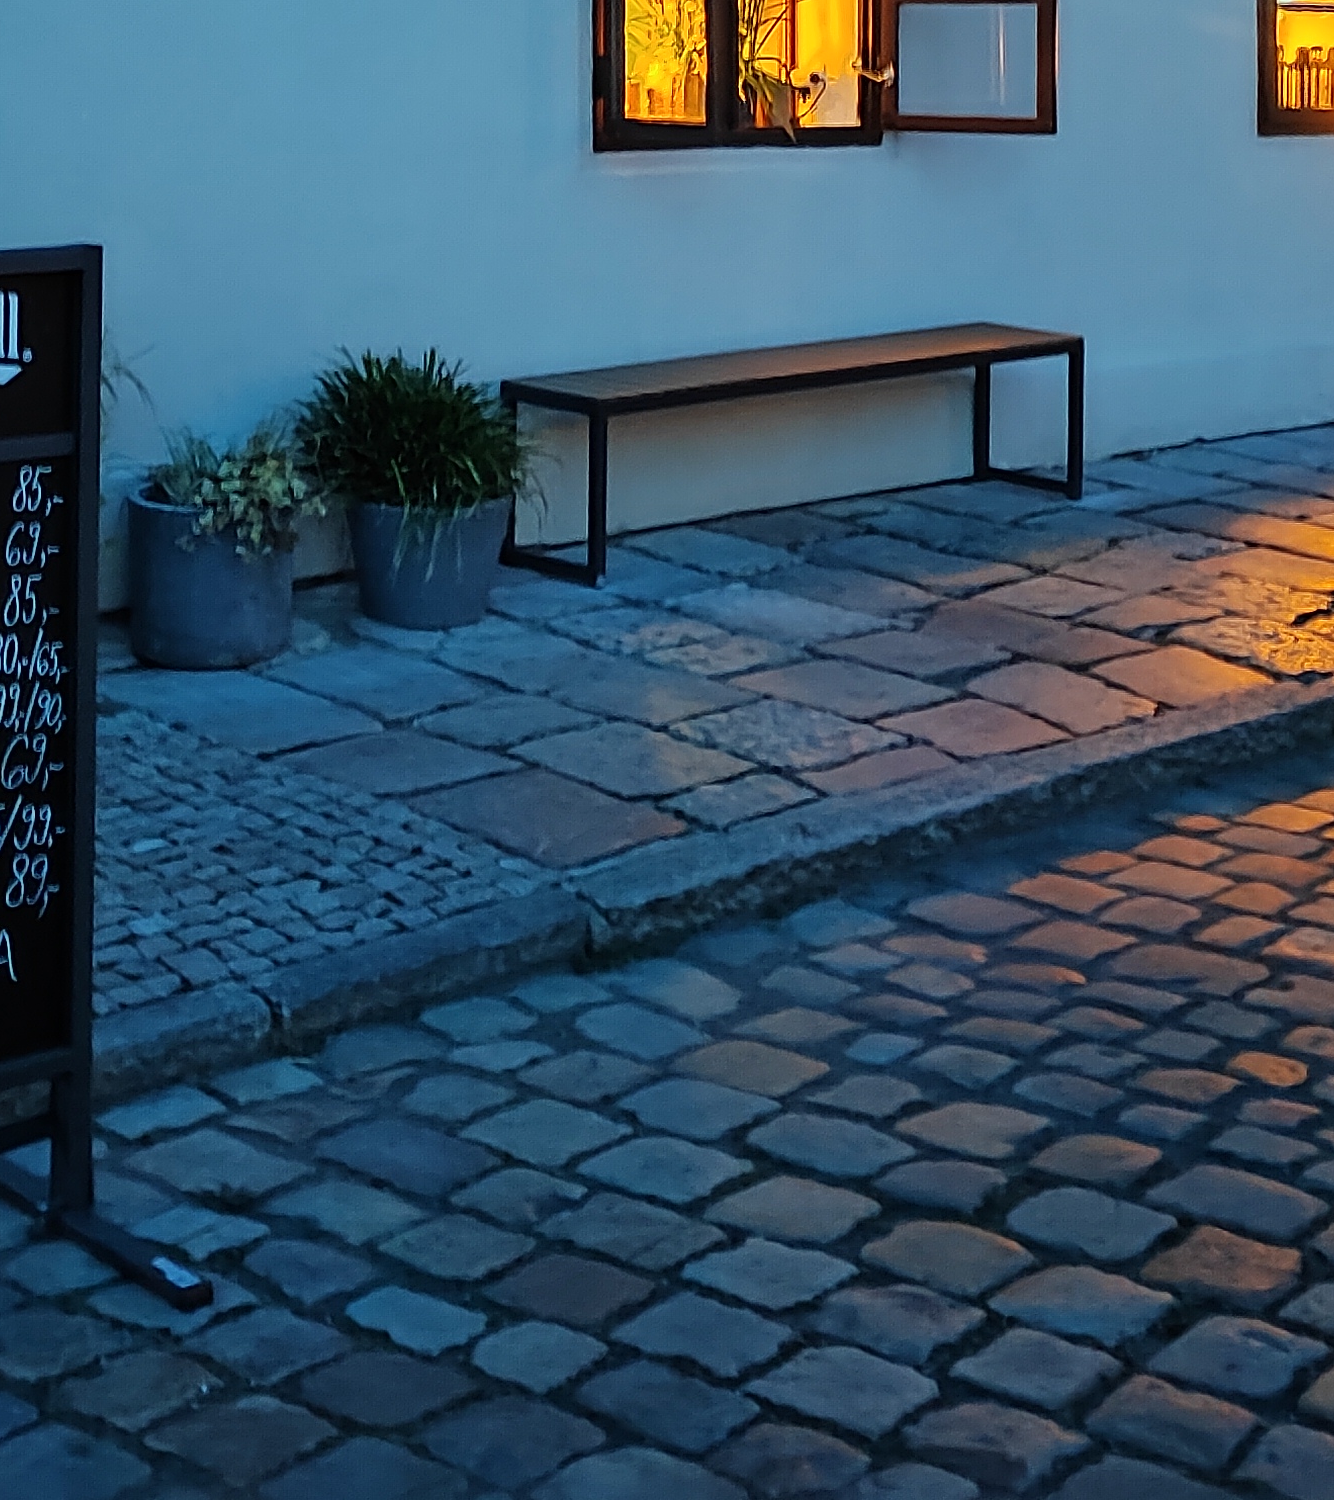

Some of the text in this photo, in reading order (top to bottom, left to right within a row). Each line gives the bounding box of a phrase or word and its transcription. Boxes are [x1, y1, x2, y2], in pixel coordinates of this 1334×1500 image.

[12, 464, 65, 518] 85,-
[3, 573, 61, 627] 85,-
[5, 852, 61, 919] 89,-
